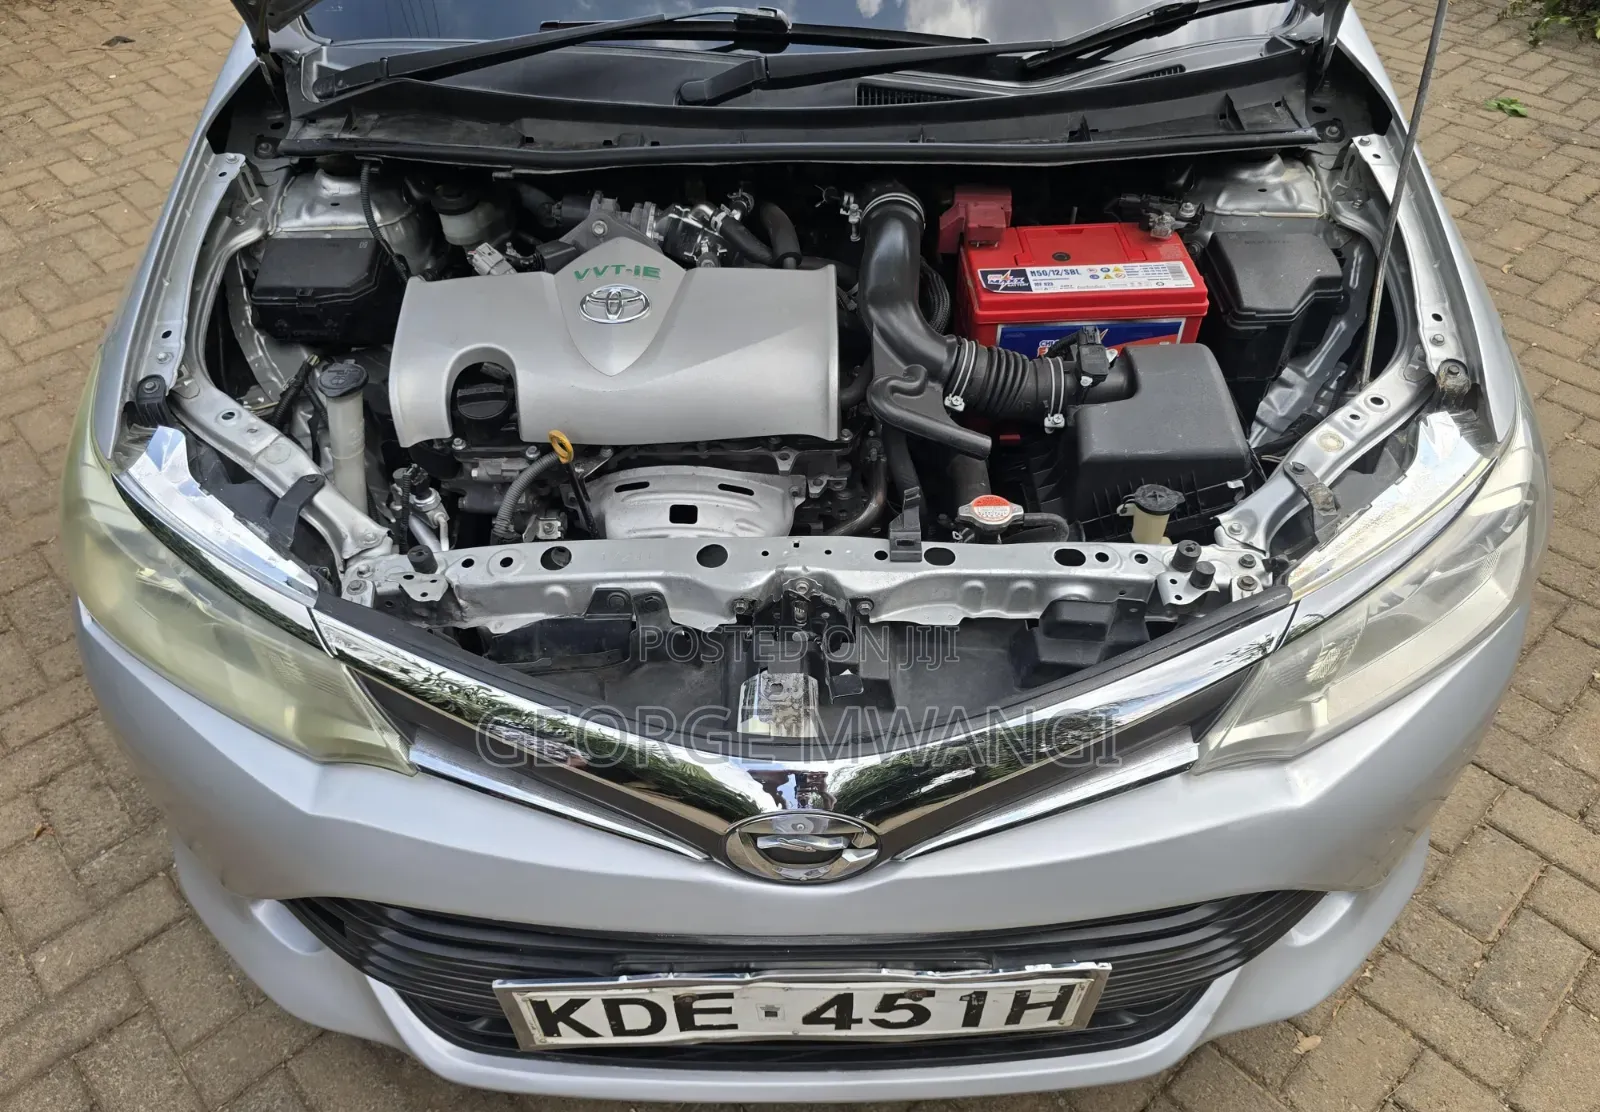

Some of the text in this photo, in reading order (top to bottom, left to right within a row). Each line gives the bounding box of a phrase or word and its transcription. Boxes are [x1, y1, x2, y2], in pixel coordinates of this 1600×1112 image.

[574, 264, 661, 280] VVT-IE
[529, 984, 1078, 1037] KDE 451H
